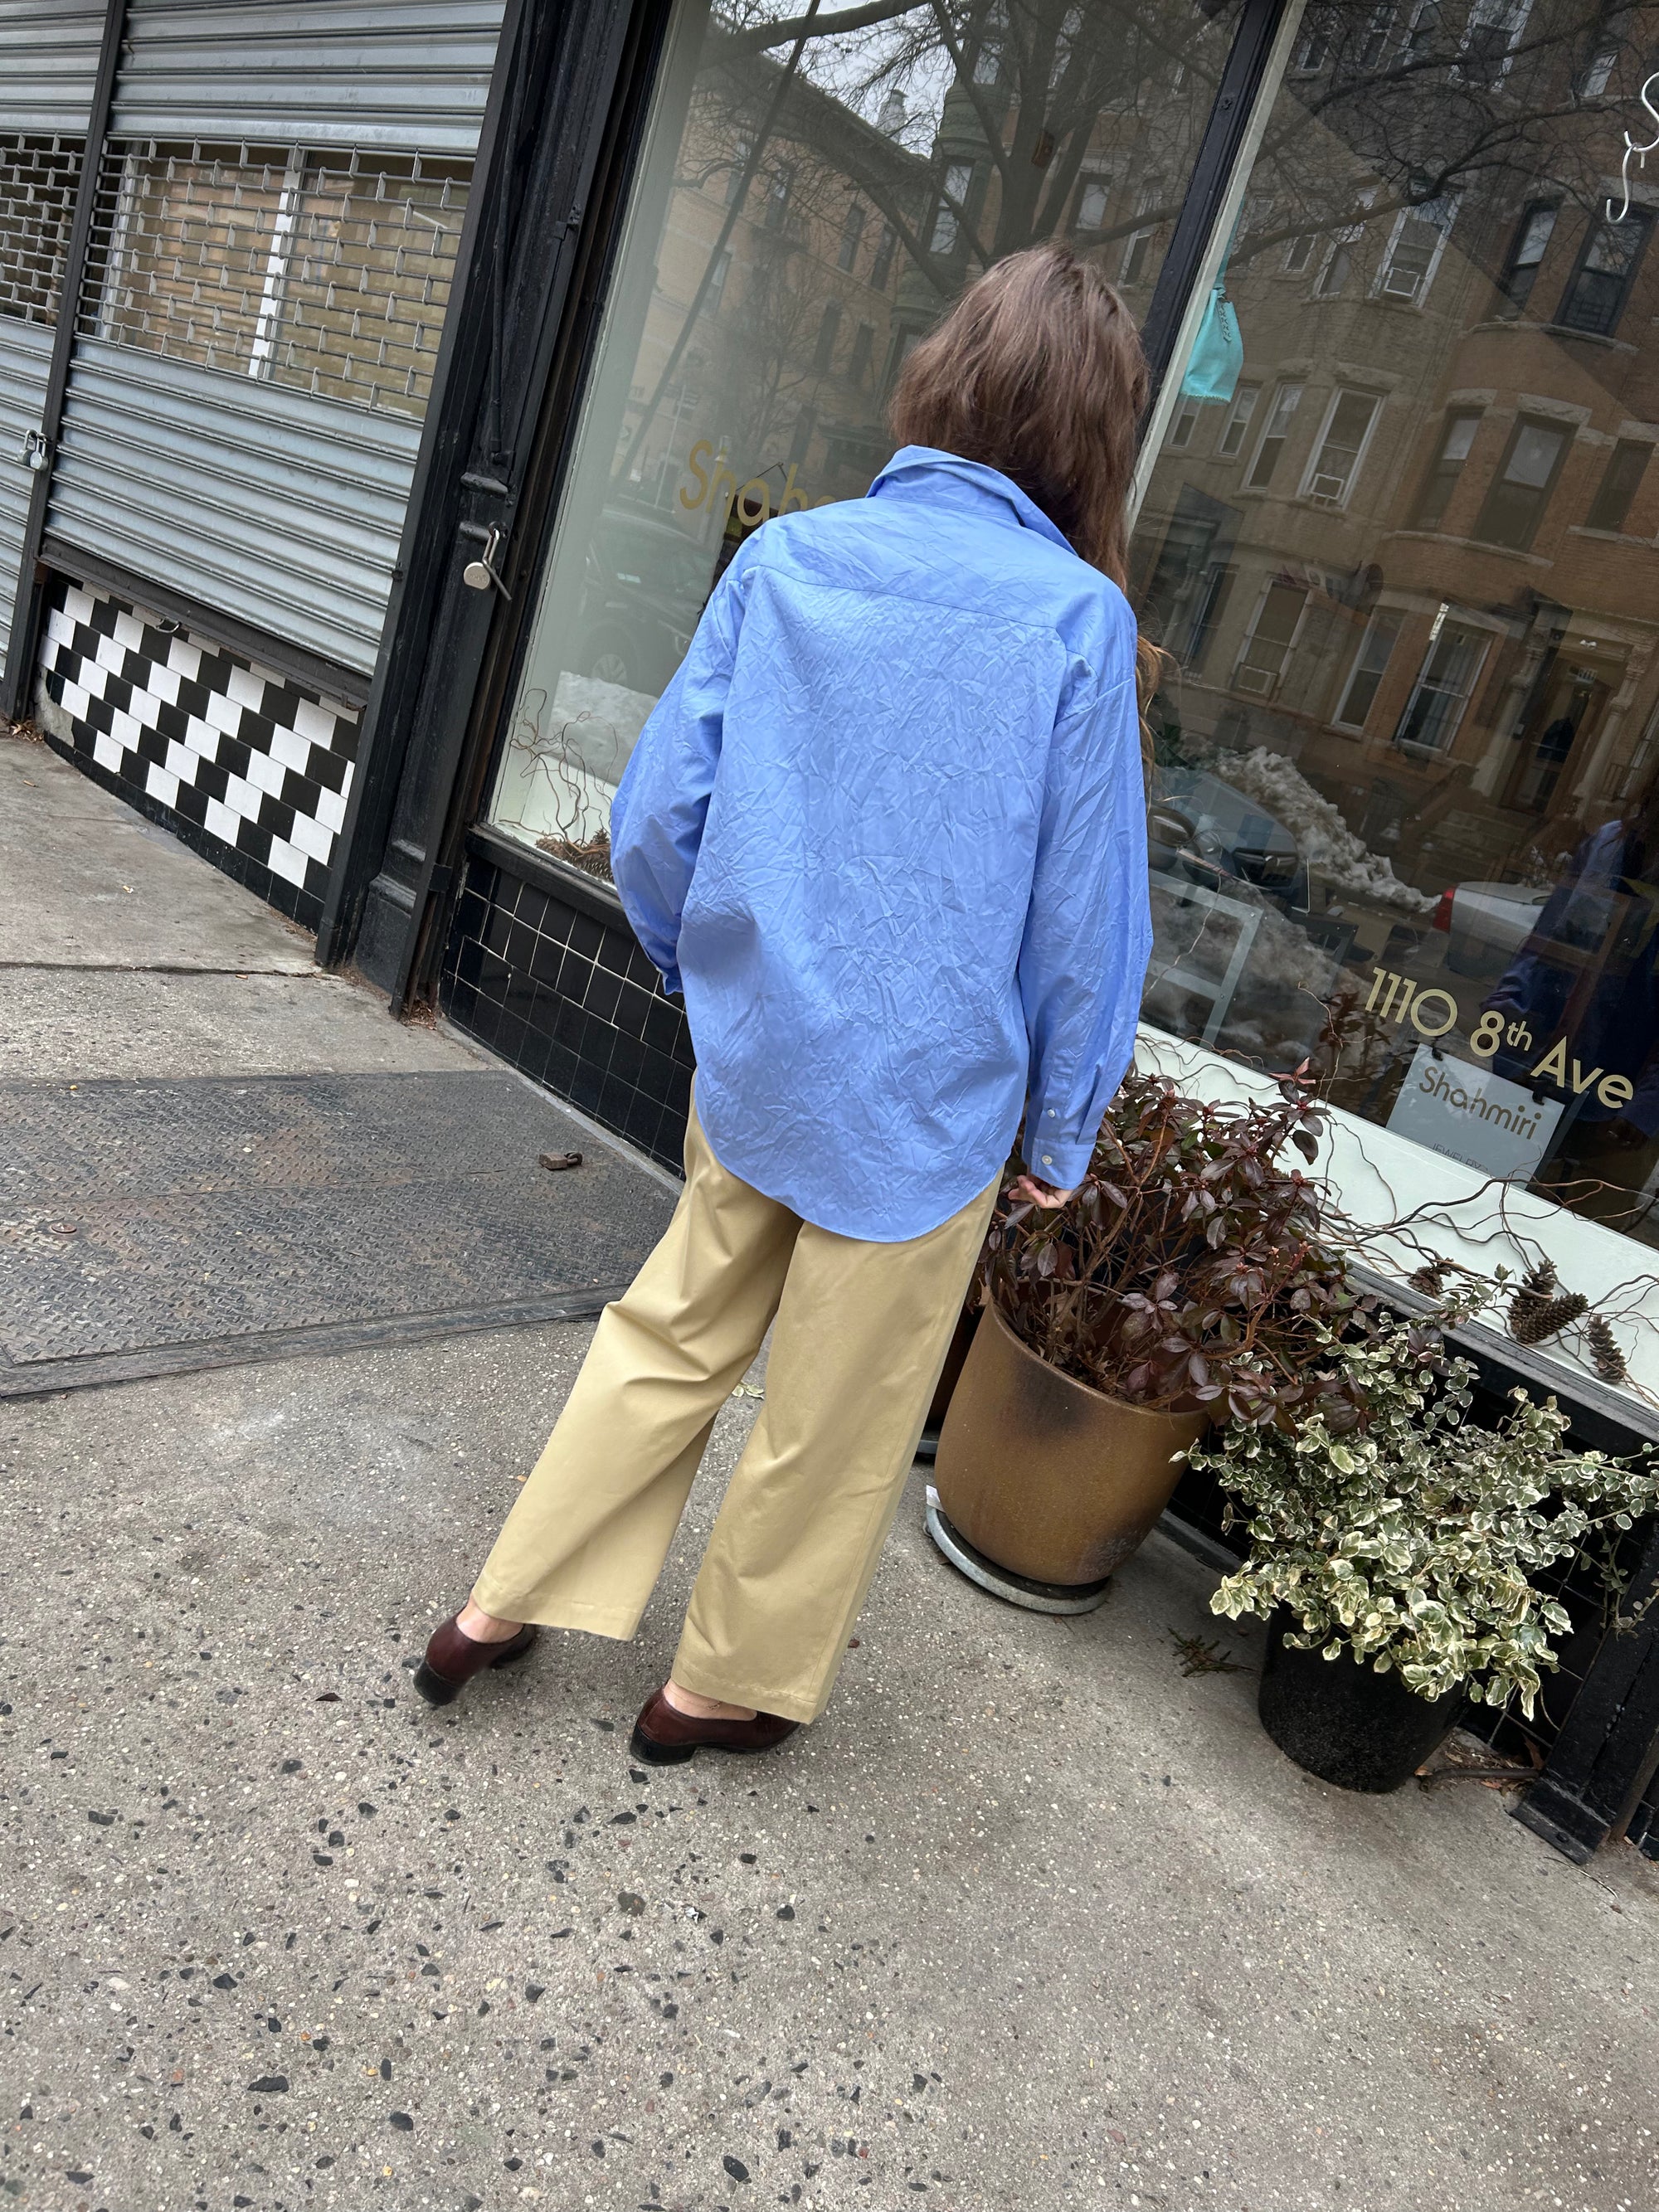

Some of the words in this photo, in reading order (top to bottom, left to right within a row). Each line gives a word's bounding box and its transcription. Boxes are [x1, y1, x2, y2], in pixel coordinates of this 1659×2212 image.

[679, 439, 836, 527] Shah
[1365, 966, 1458, 1037] 1110
[1469, 1010, 1533, 1057] 8th
[1530, 1035, 1634, 1109] Ave
[1418, 1066, 1542, 1140] Shahmiri
